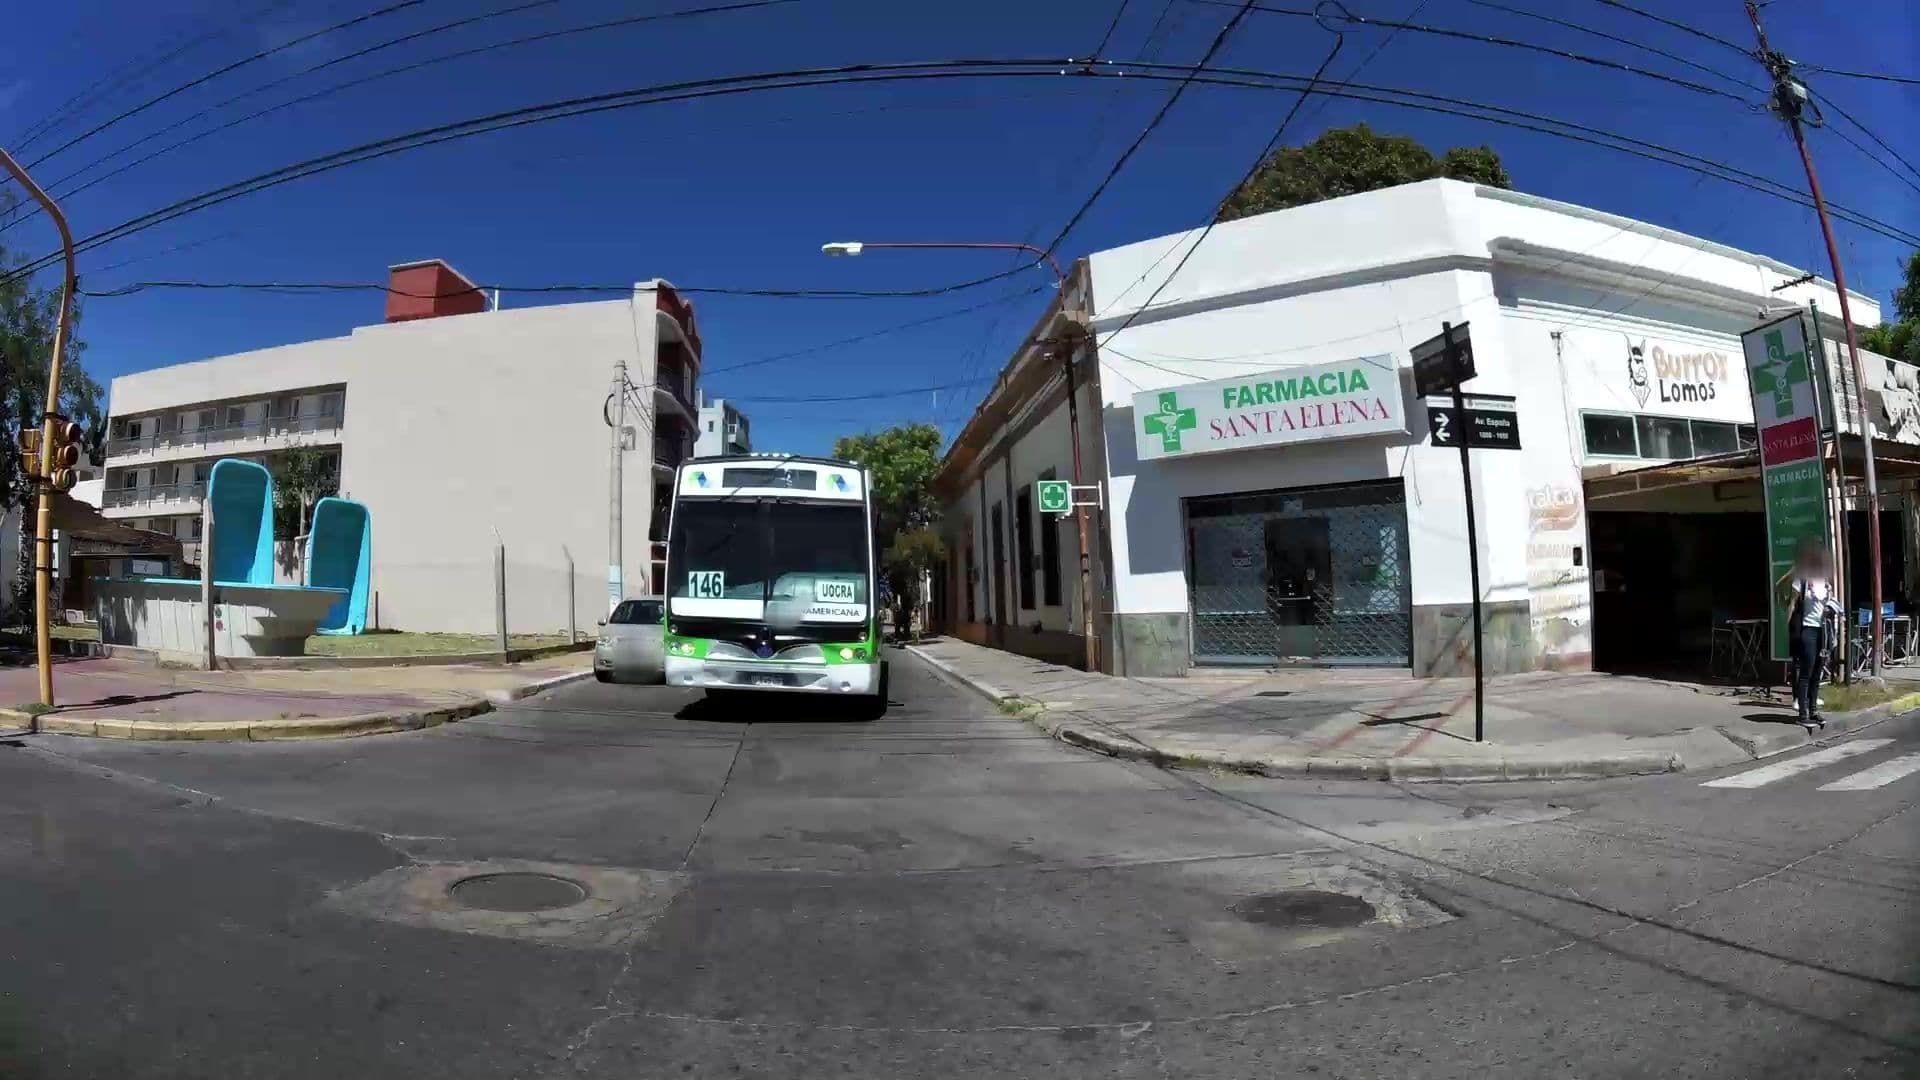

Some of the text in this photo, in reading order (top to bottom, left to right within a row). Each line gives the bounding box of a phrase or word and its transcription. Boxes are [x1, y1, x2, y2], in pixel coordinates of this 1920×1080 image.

[1223, 368, 1369, 409] FARMACIA
[1659, 379, 1716, 403] Lomos
[1767, 466, 1819, 486] FARMACIA
[690, 573, 723, 597] 146
[822, 583, 853, 599] UOCRA
[801, 607, 860, 617] AMERICANA
